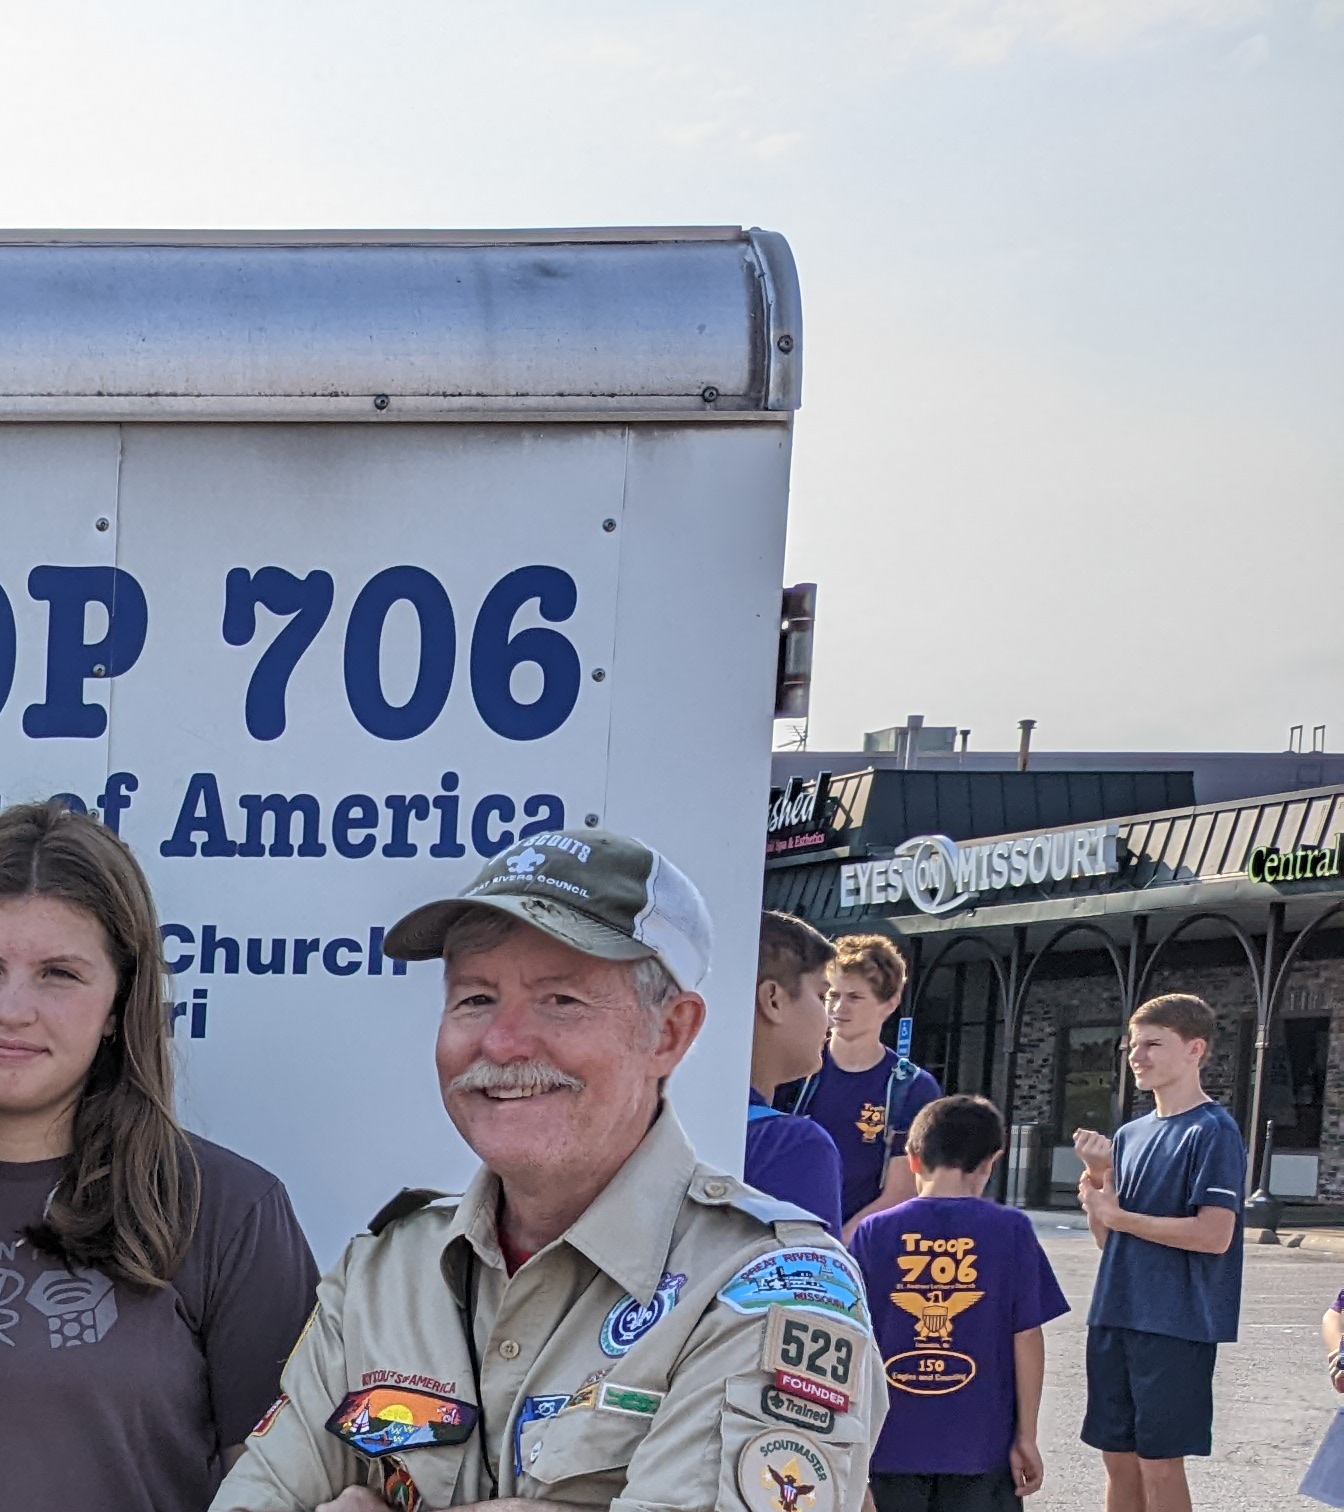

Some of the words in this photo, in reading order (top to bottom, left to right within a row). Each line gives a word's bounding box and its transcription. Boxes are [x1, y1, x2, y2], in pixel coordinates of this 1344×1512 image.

[222, 565, 582, 742] 706
[159, 771, 565, 859] America
[840, 856, 904, 908] EYES
[917, 854, 946, 891] ON
[955, 825, 1119, 894] MISSOURI
[1248, 833, 1340, 884] Central
[536, 874, 591, 899] COUNCIL
[158, 923, 408, 975] Church
[783, 1251, 827, 1263] RIVERS
[901, 1233, 975, 1260] Troop
[896, 1254, 978, 1284] 706
[780, 1318, 853, 1385] 523
[918, 1359, 945, 1372] 150
[408, 1374, 457, 1394] AMERICA
[782, 1374, 846, 1406] FOUNDER
[786, 1398, 829, 1424] Trained
[759, 1439, 828, 1482] SCOUTMASTER
